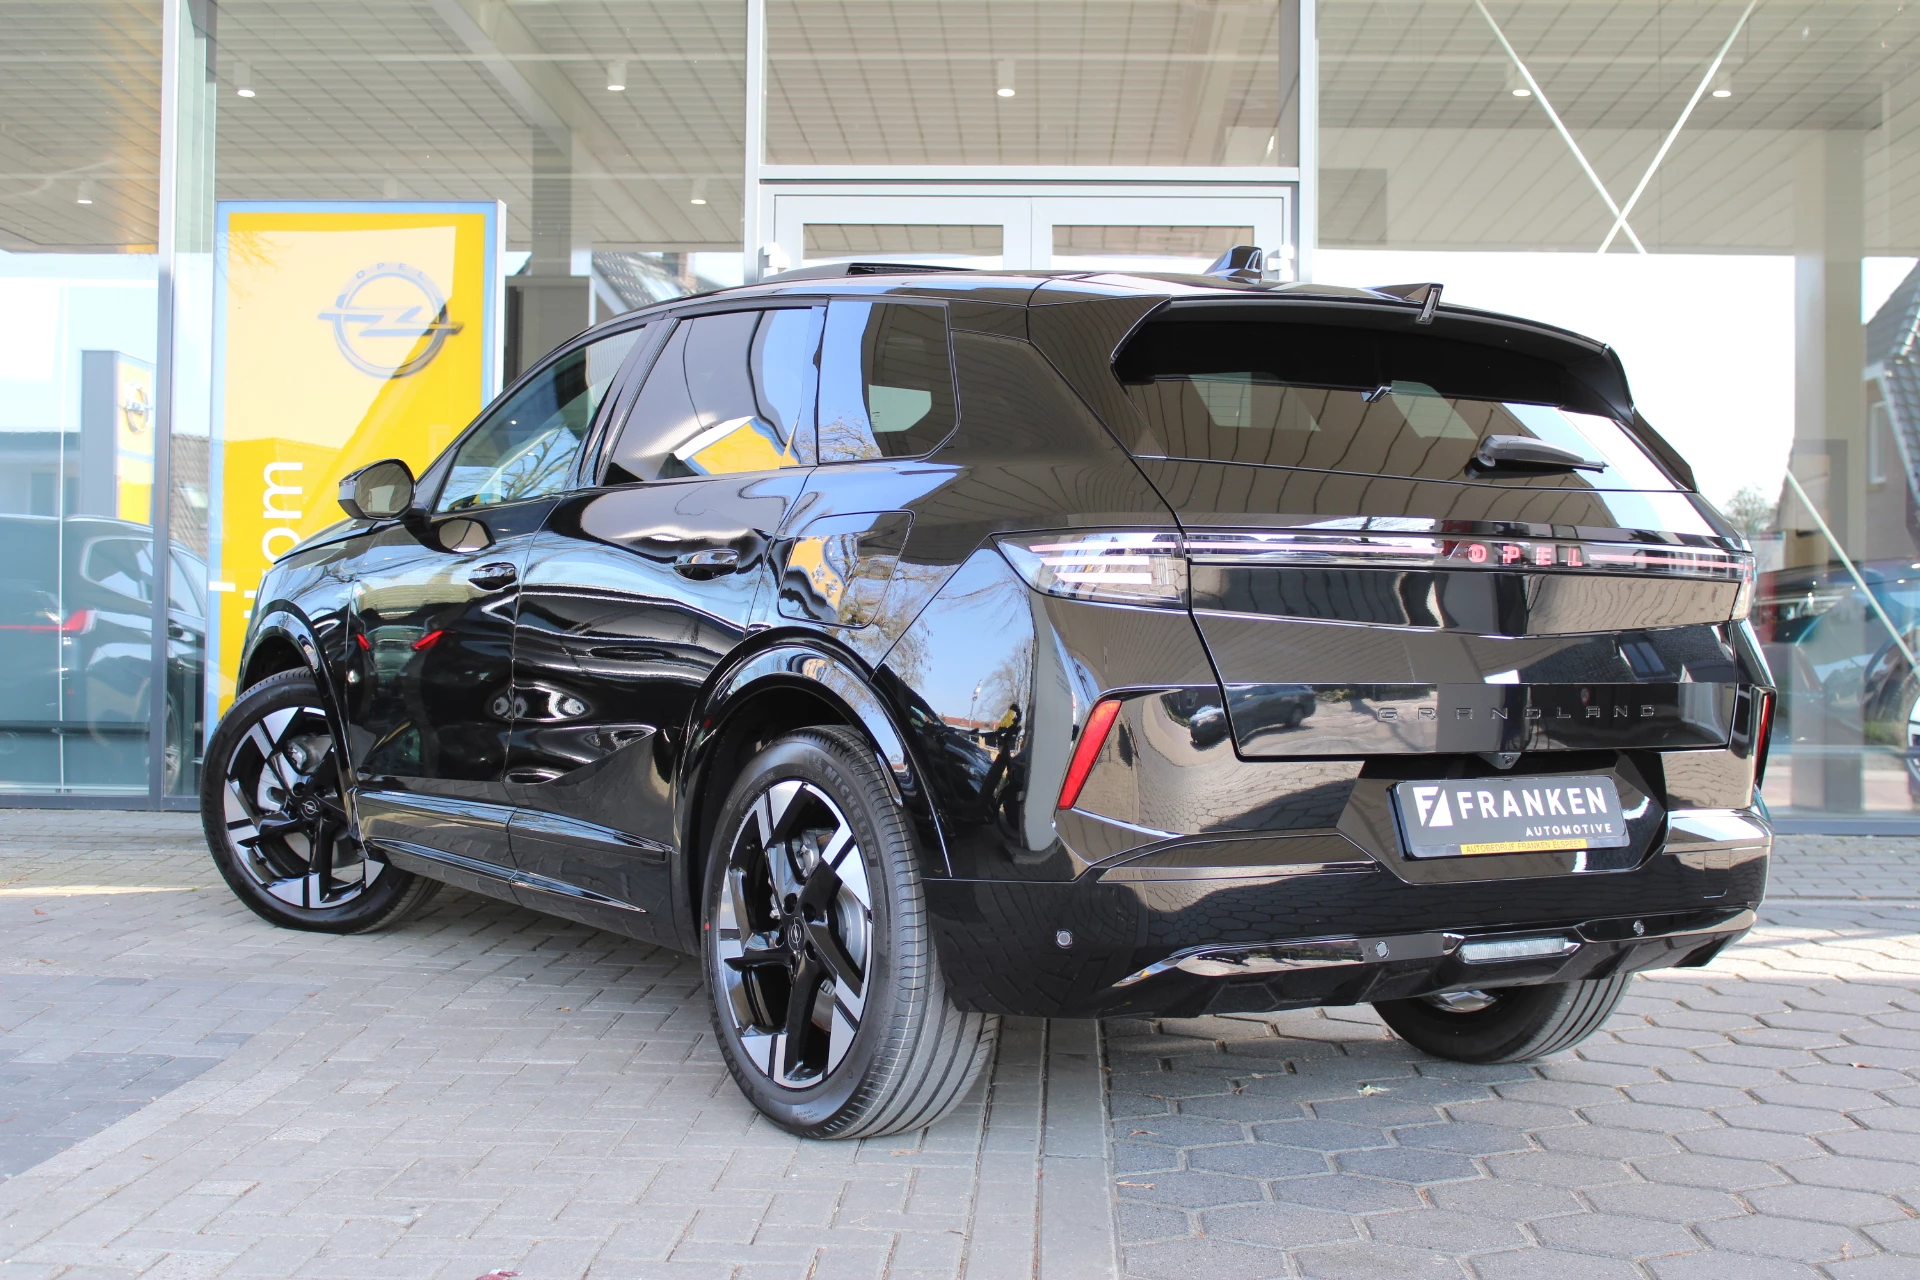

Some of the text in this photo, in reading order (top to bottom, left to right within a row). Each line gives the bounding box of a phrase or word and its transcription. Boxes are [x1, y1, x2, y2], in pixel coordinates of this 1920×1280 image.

[355, 262, 425, 281] OPEL
[1467, 543, 1584, 567] OPEL
[1377, 705, 1655, 722] GRANDLAND
[1456, 787, 1607, 819] FRANKEN
[824, 766, 878, 861] MICHELIN
[1525, 823, 1612, 837] AUTOMOTIVE
[1466, 840, 1583, 853] AUTOBEDRIJF FRANKEN ELSPEET
